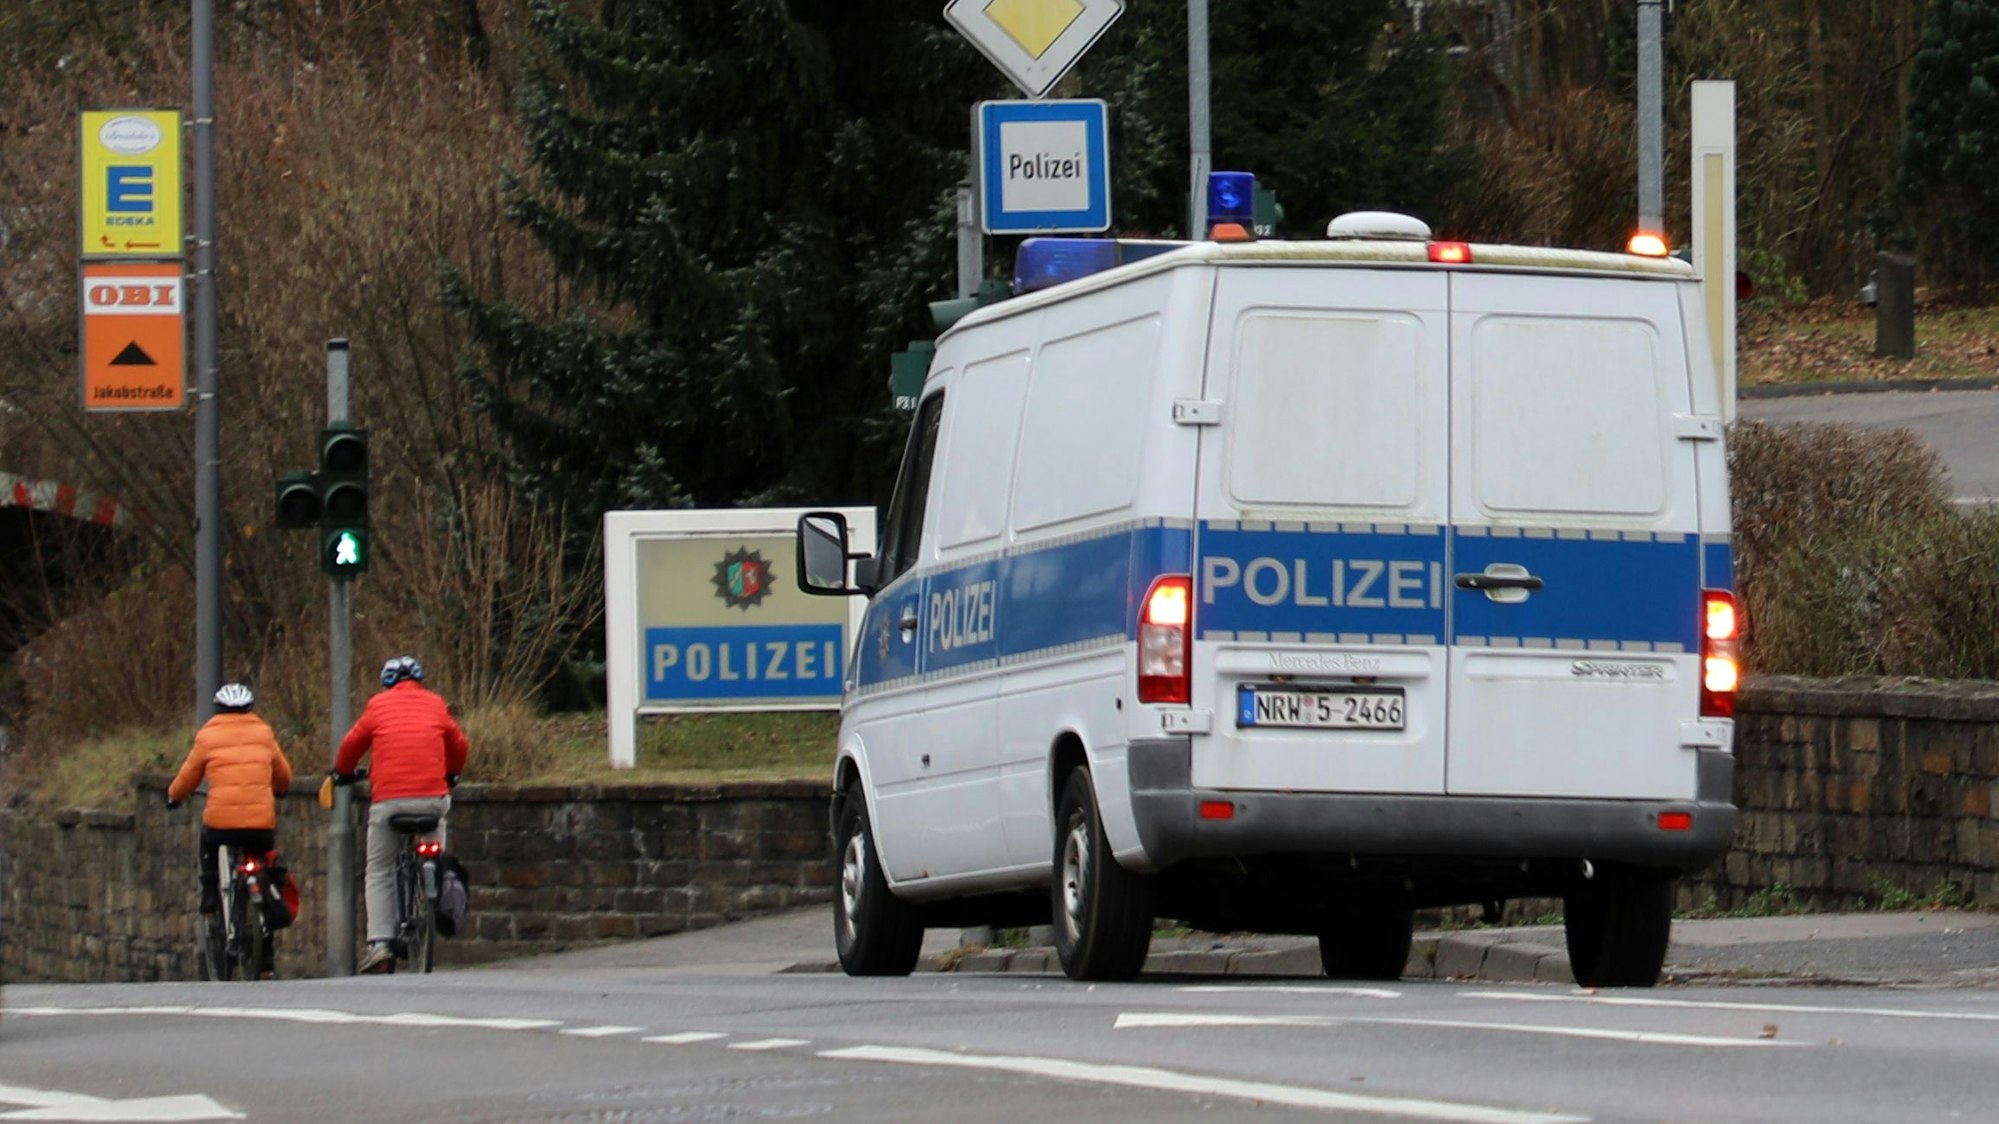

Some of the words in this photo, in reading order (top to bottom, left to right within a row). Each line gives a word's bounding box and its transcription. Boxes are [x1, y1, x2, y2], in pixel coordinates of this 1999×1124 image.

[1009, 152, 1081, 179] Polizei
[107, 166, 153, 212] E
[106, 216, 154, 226] EDEKA
[89, 284, 175, 306] OBI
[1202, 556, 1442, 609] POLIZEI
[929, 580, 996, 654] POLIZEI
[654, 640, 836, 682] POLIZEI
[1256, 695, 1301, 722] NRW
